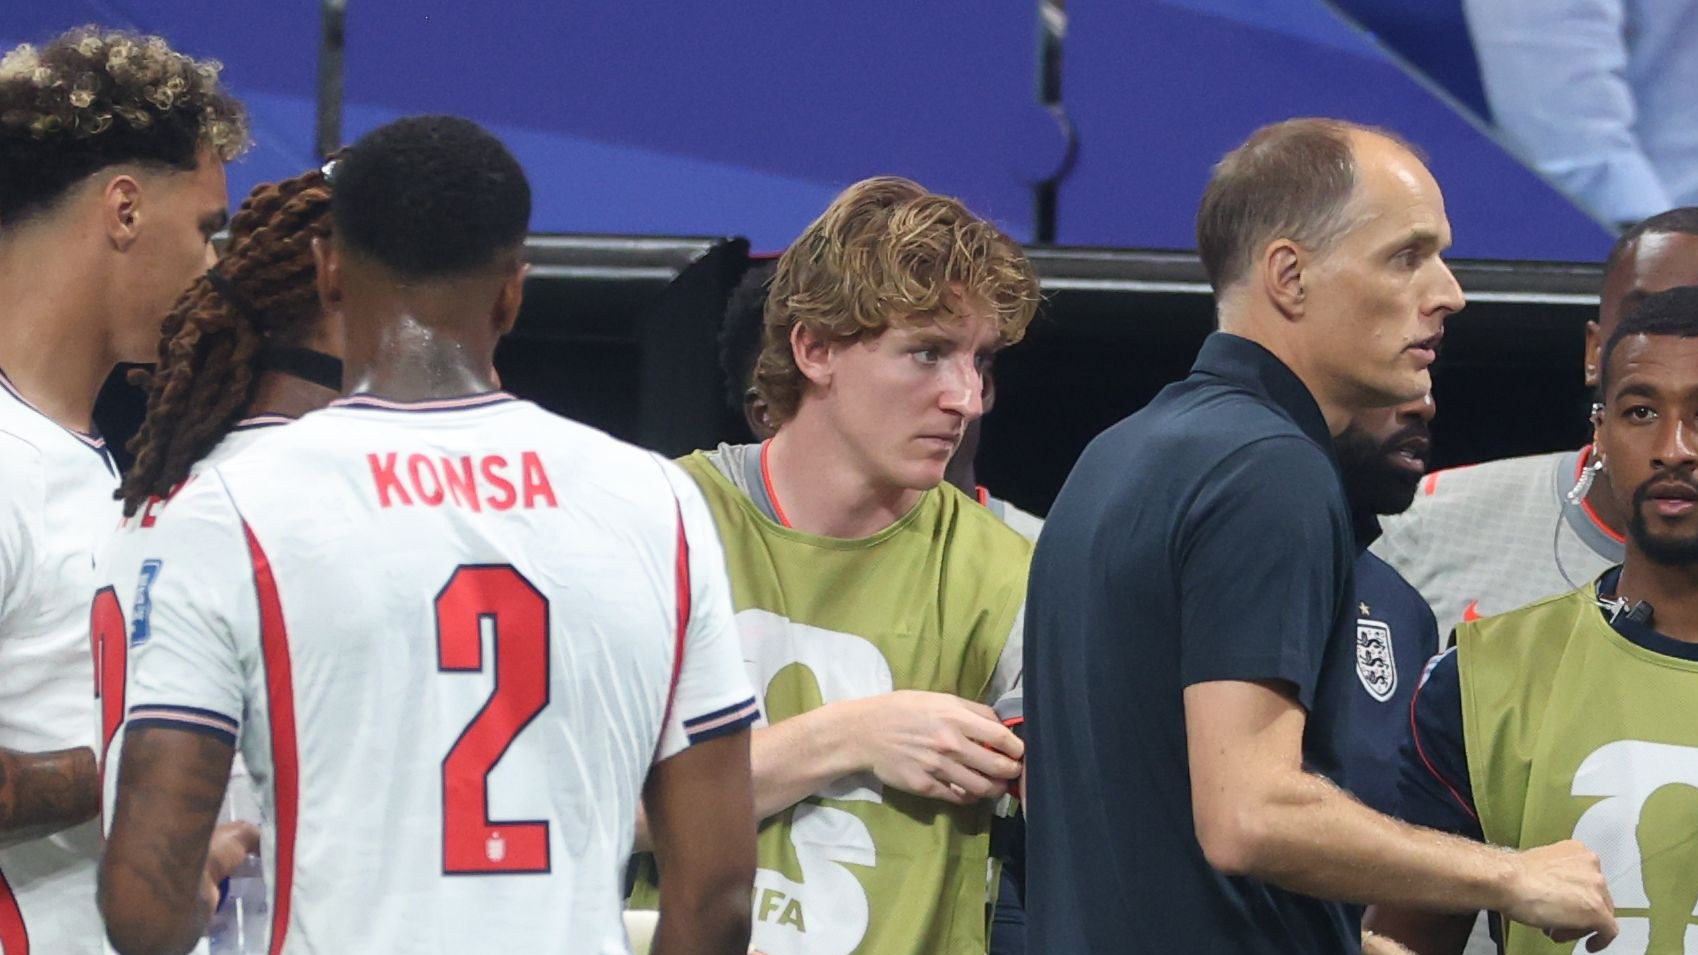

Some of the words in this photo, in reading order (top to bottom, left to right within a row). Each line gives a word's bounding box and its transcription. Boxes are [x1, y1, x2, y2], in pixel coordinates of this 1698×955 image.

[367, 451, 559, 514] KONSA
[434, 562, 552, 876] 2
[752, 886, 806, 933] FA
